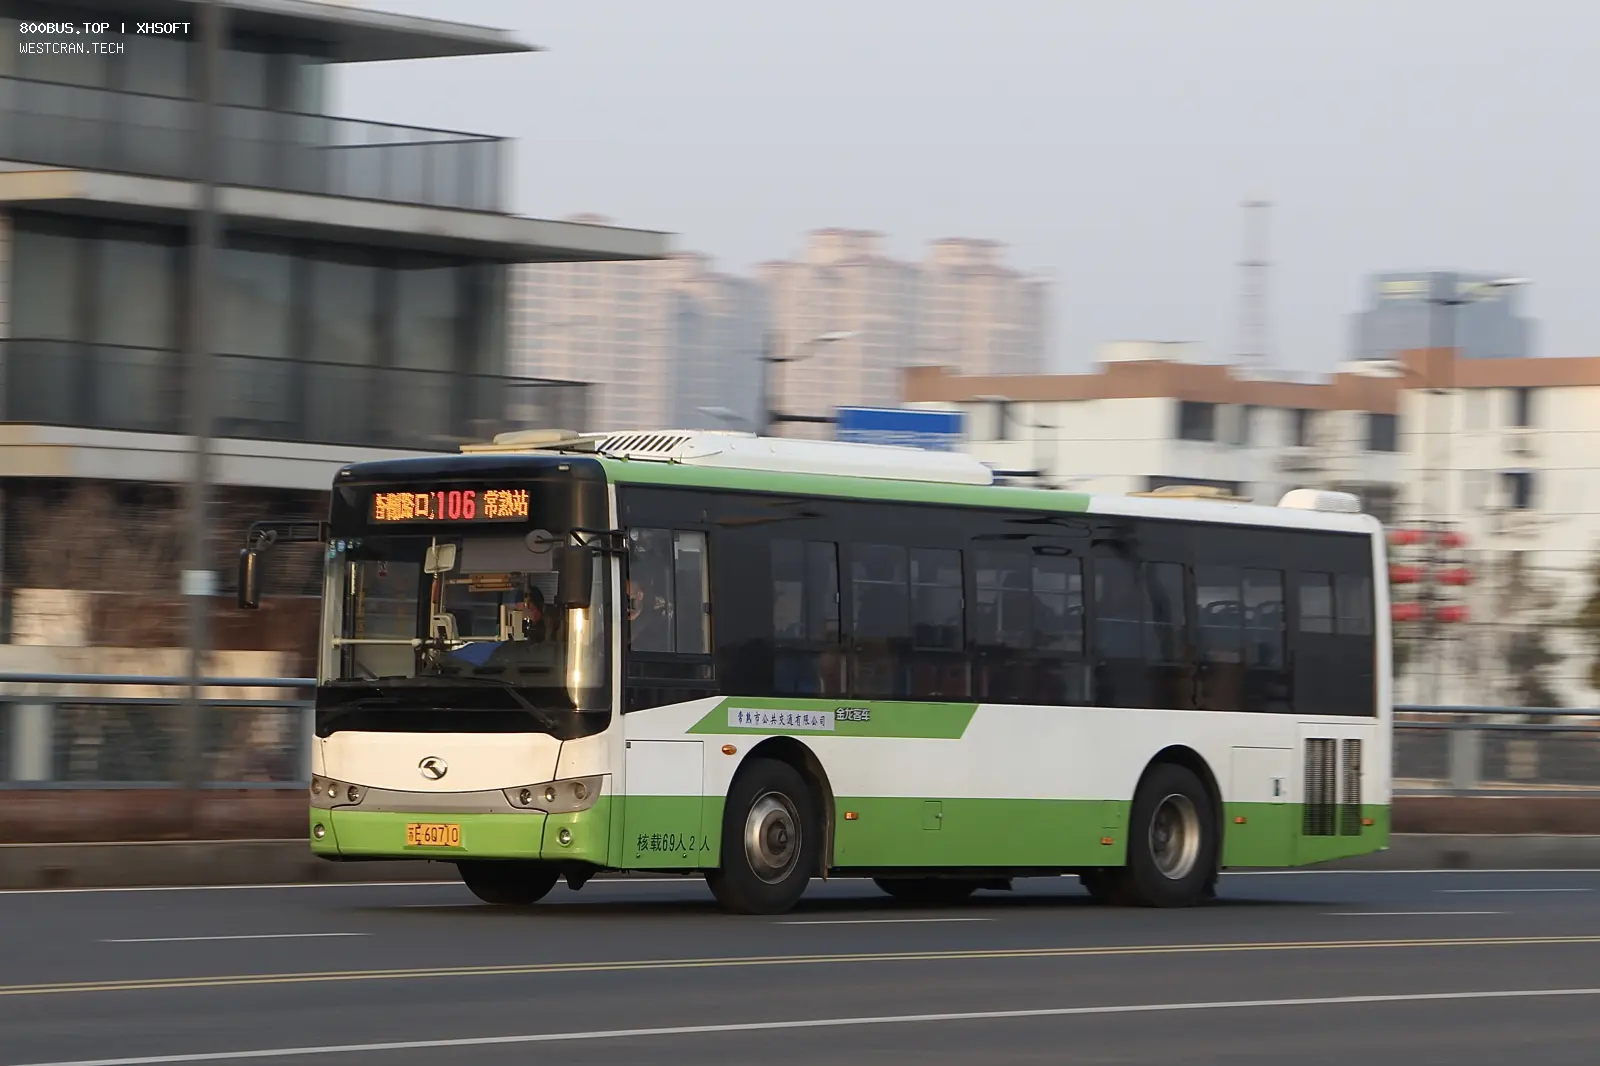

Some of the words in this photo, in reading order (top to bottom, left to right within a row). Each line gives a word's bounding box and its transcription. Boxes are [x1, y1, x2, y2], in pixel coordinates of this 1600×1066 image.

[437, 490, 477, 520] 106
[483, 489, 529, 518] 常熟站
[737, 710, 826, 727] 常熟市公共交通有限公司
[835, 707, 871, 722] 金龙客车
